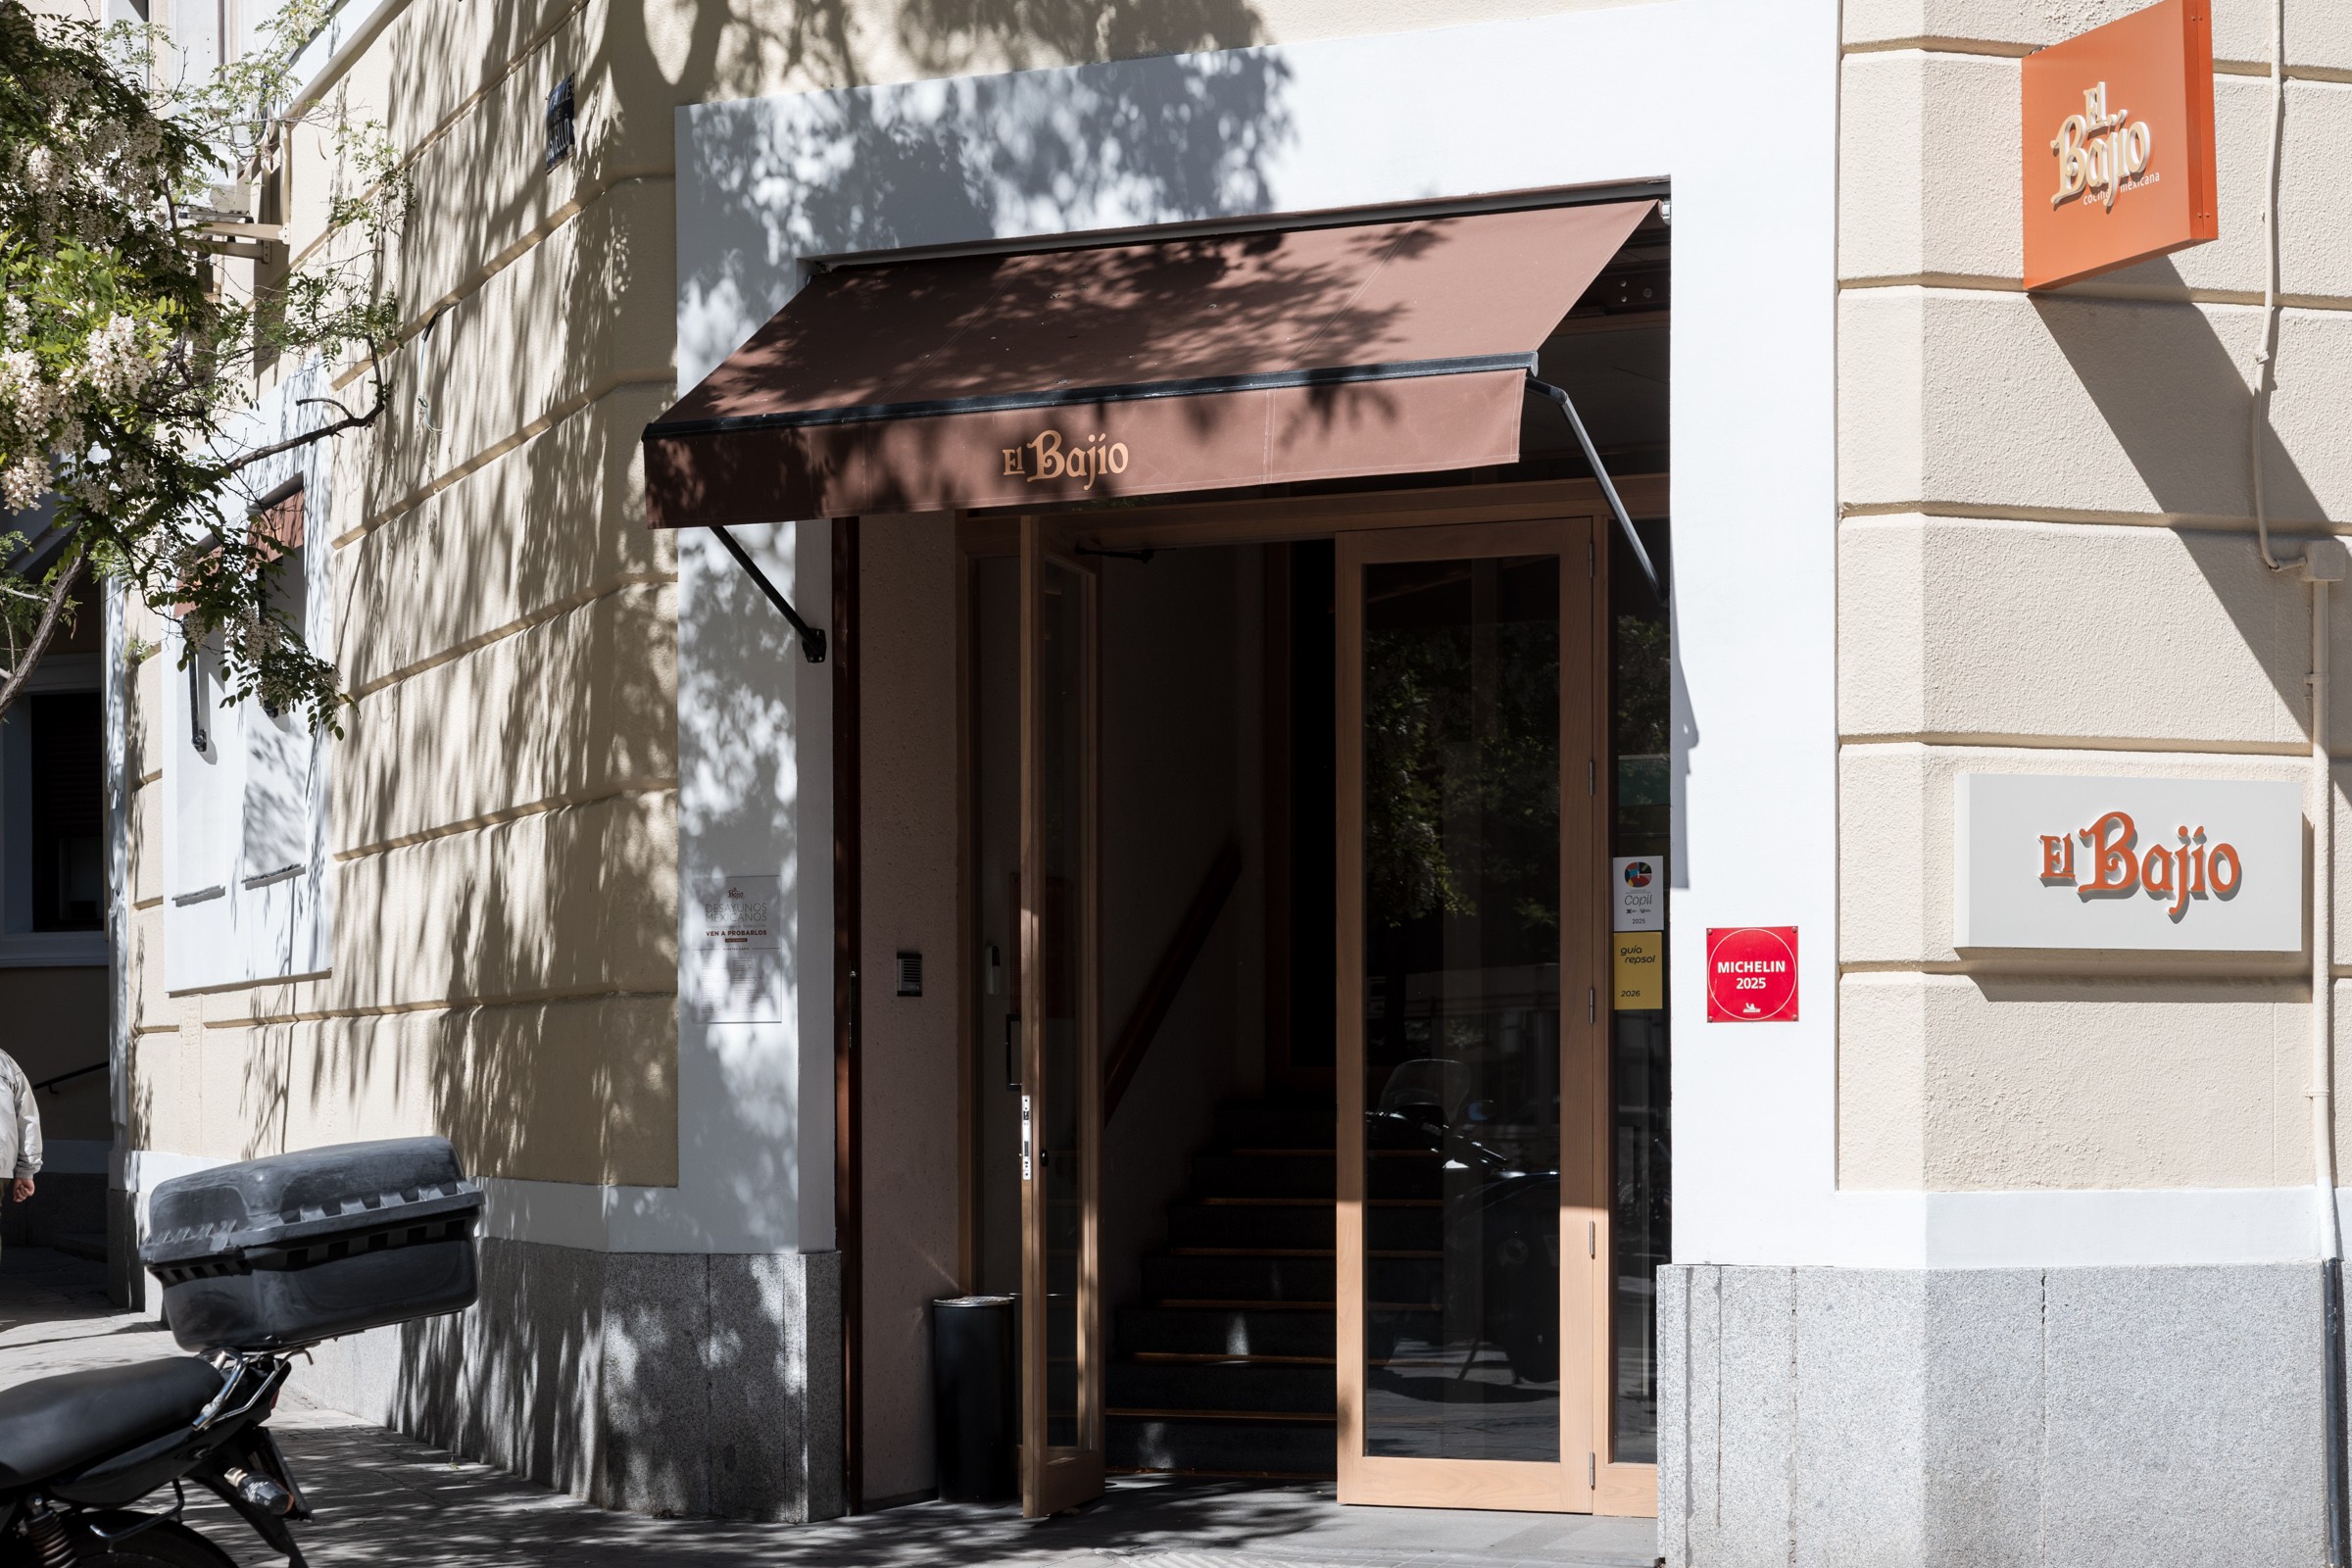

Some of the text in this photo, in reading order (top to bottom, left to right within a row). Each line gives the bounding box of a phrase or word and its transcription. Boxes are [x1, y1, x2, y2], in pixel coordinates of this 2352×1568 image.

[2082, 81, 2109, 132] El
[2049, 109, 2151, 207] Bajío
[1002, 429, 1129, 491] El Bajío
[2038, 810, 2241, 915] El Bajío
[1624, 894, 1653, 906] Copil
[705, 902, 767, 913] DESAYUNOS
[705, 911, 767, 922] MEXICANOS
[1620, 944, 1642, 956] guía
[1624, 955, 1656, 965] repsol
[1717, 960, 1786, 974] MICHELIN
[1736, 977, 1767, 990] 2025
